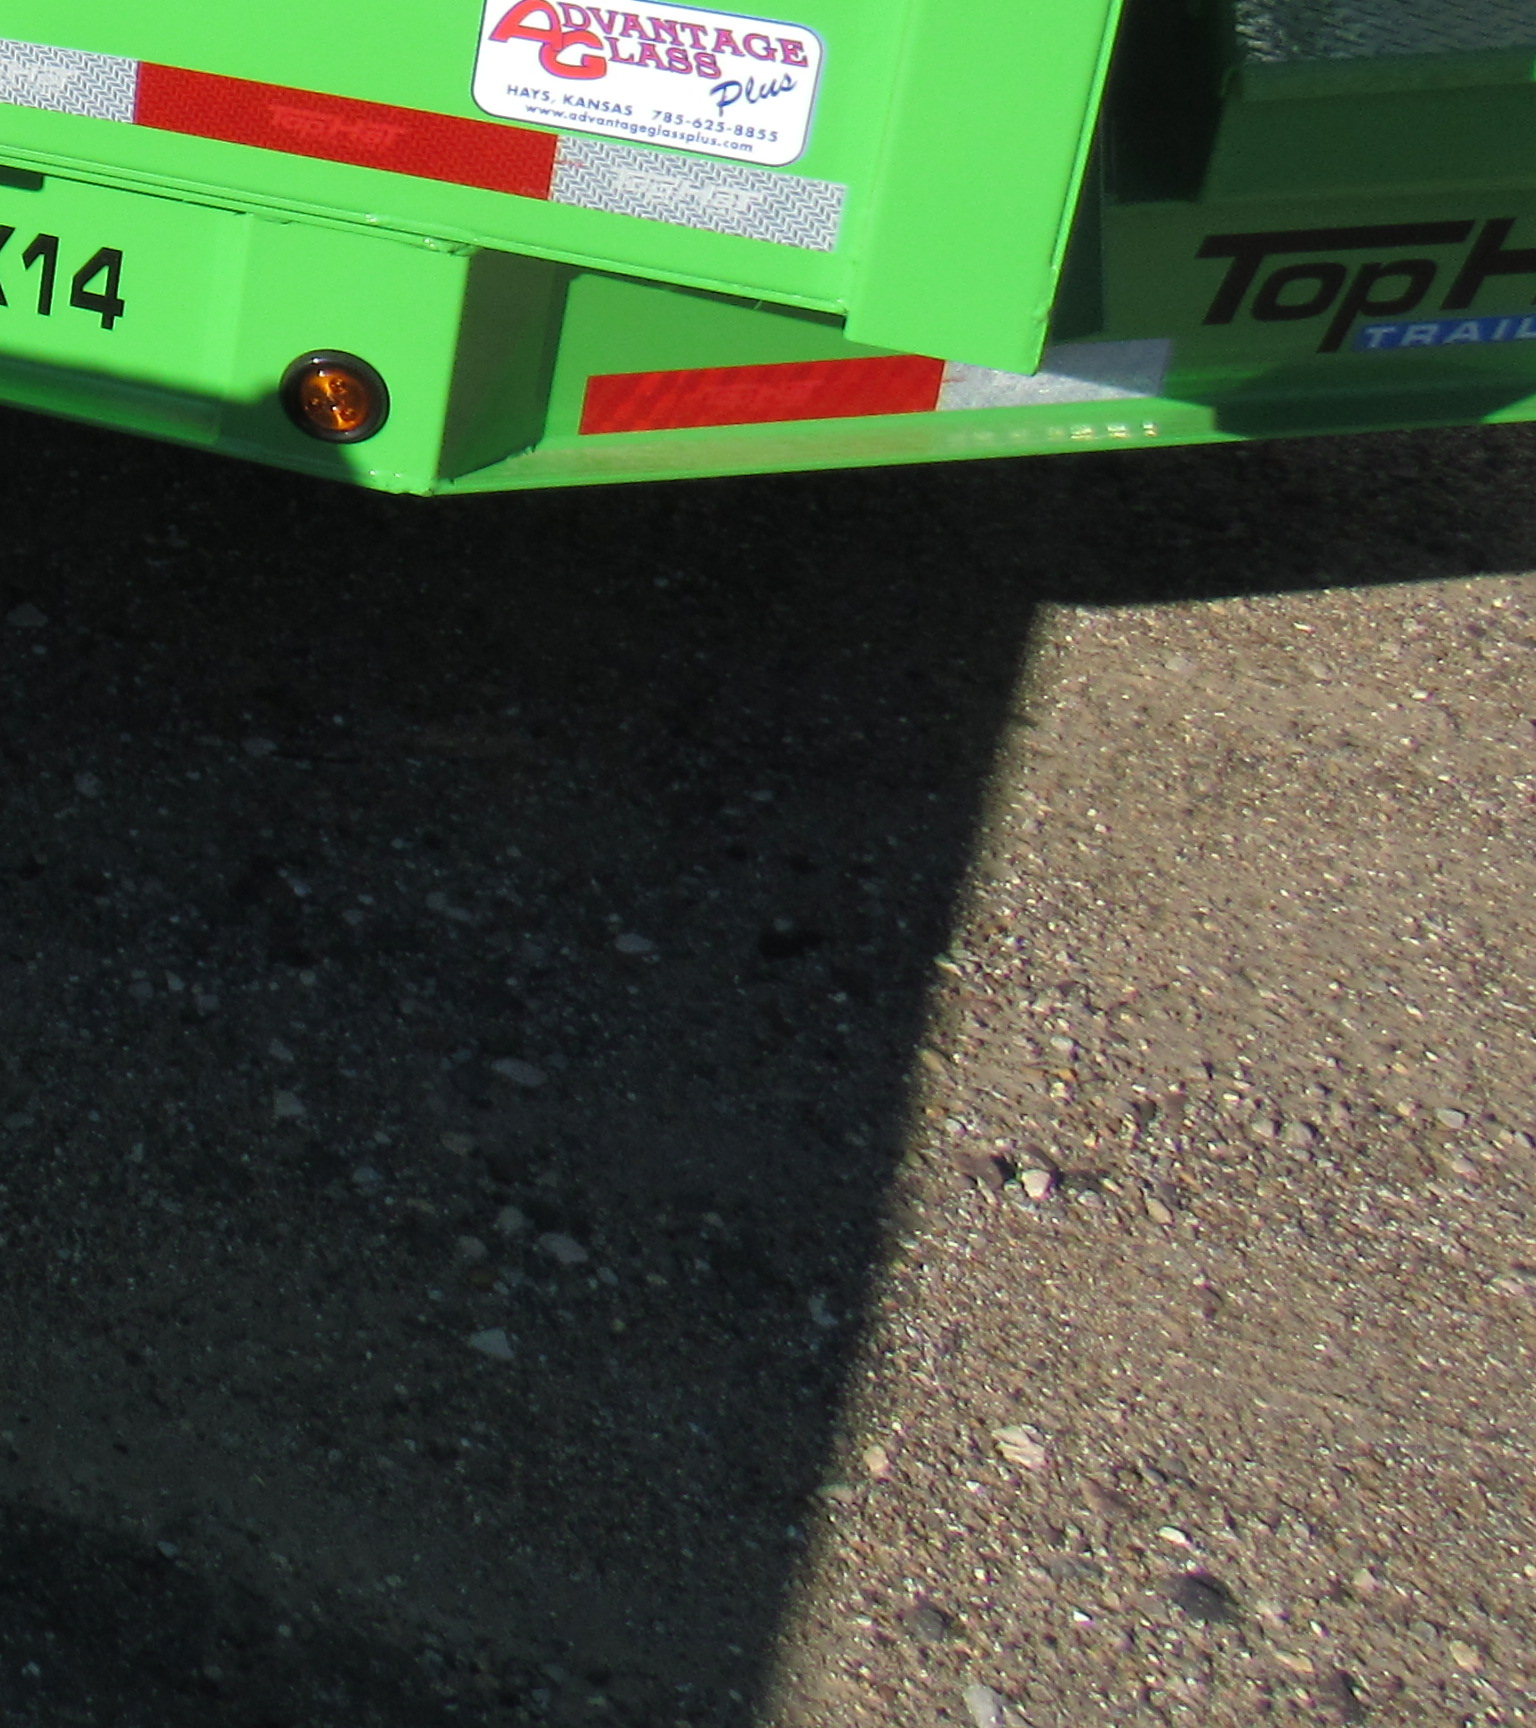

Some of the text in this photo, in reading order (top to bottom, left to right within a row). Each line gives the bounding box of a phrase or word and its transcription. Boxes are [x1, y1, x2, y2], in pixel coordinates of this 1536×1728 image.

[539, 30, 722, 80] GLASS
[525, 104, 754, 153] www.advantageglassplus.com
[563, 93, 634, 118] KANSAS
[651, 109, 780, 144] 785-625-8855
